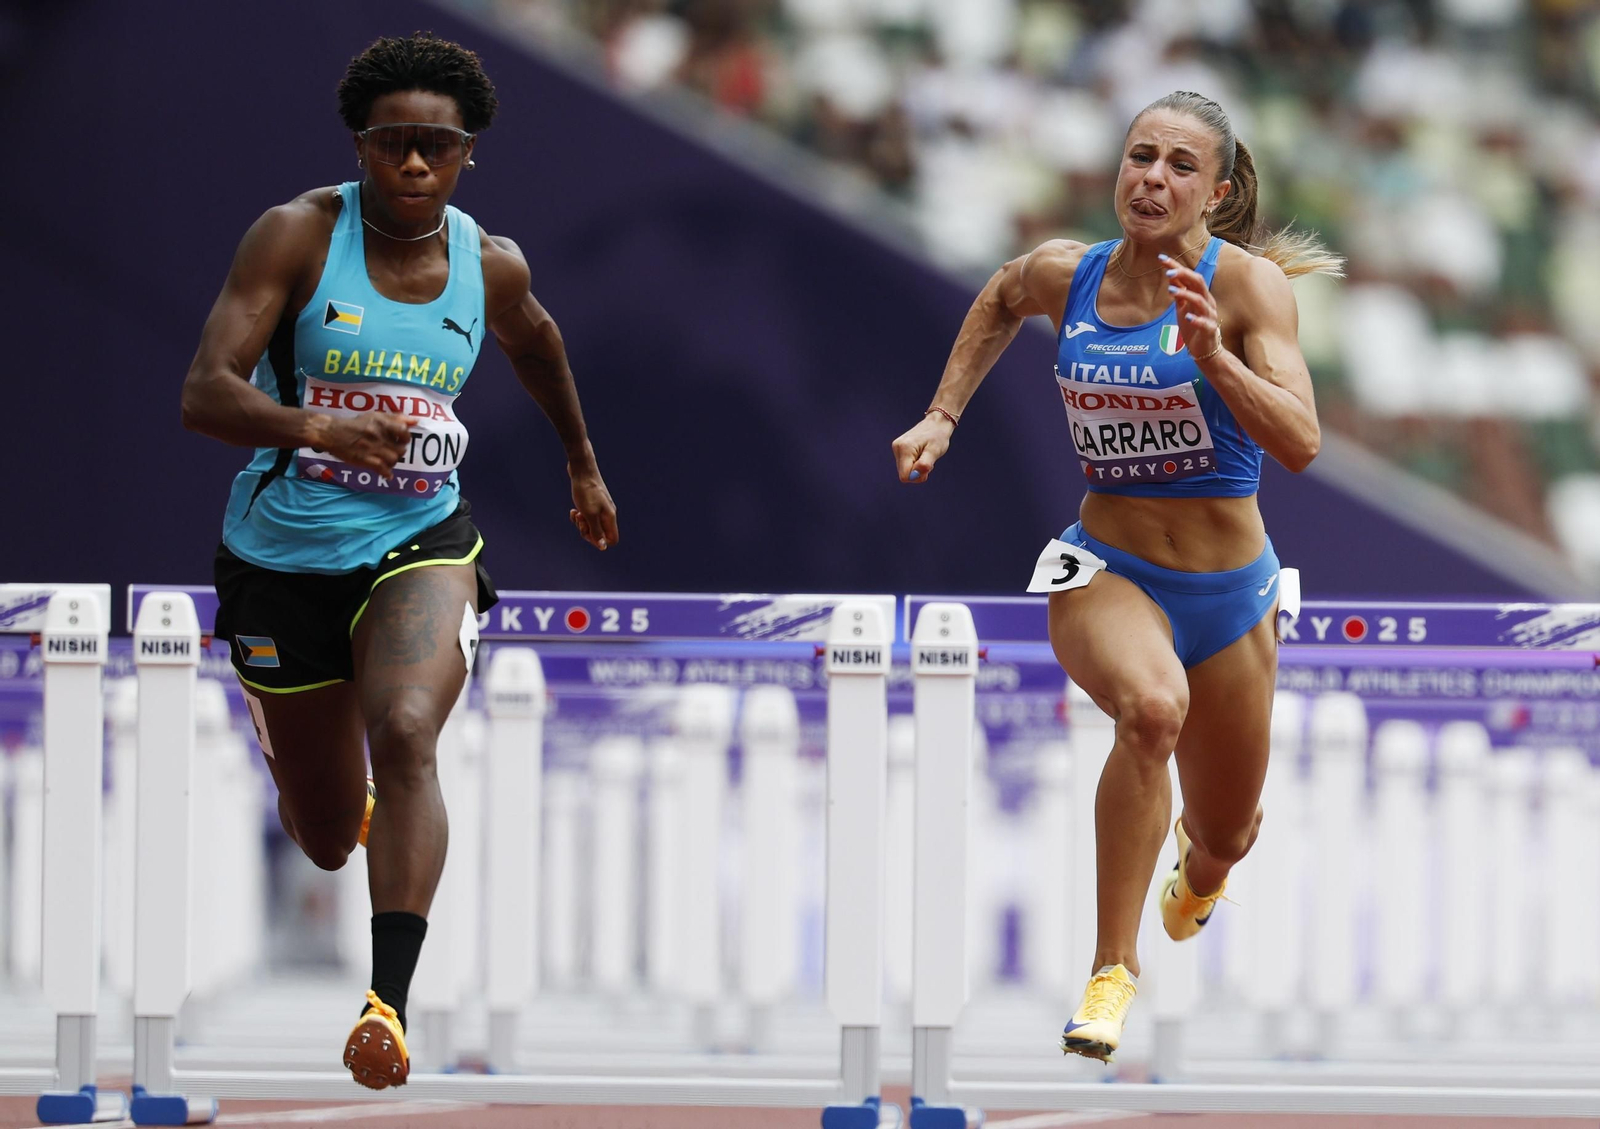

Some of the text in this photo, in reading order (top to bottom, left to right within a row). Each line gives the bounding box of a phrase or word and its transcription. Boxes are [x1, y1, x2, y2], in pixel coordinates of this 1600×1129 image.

[1086, 343, 1150, 352] FRECCIAROSSA
[324, 350, 464, 391] BAHAMAS
[1071, 363, 1158, 384] ITALIA
[308, 386, 456, 423] HONDA
[1061, 386, 1196, 411] HONDA
[1072, 419, 1202, 457] CARRARO
[1182, 456, 1210, 472] 25
[1050, 552, 1081, 585] 3
[600, 606, 650, 633] 25
[1377, 616, 1428, 643] 25
[48, 636, 98, 655] NISHI
[141, 639, 190, 656] NISHI
[832, 650, 881, 664] NISHI
[919, 651, 968, 666] NISHI
[1278, 666, 1600, 699] ORLD ATHLETICS CHAMPIO
